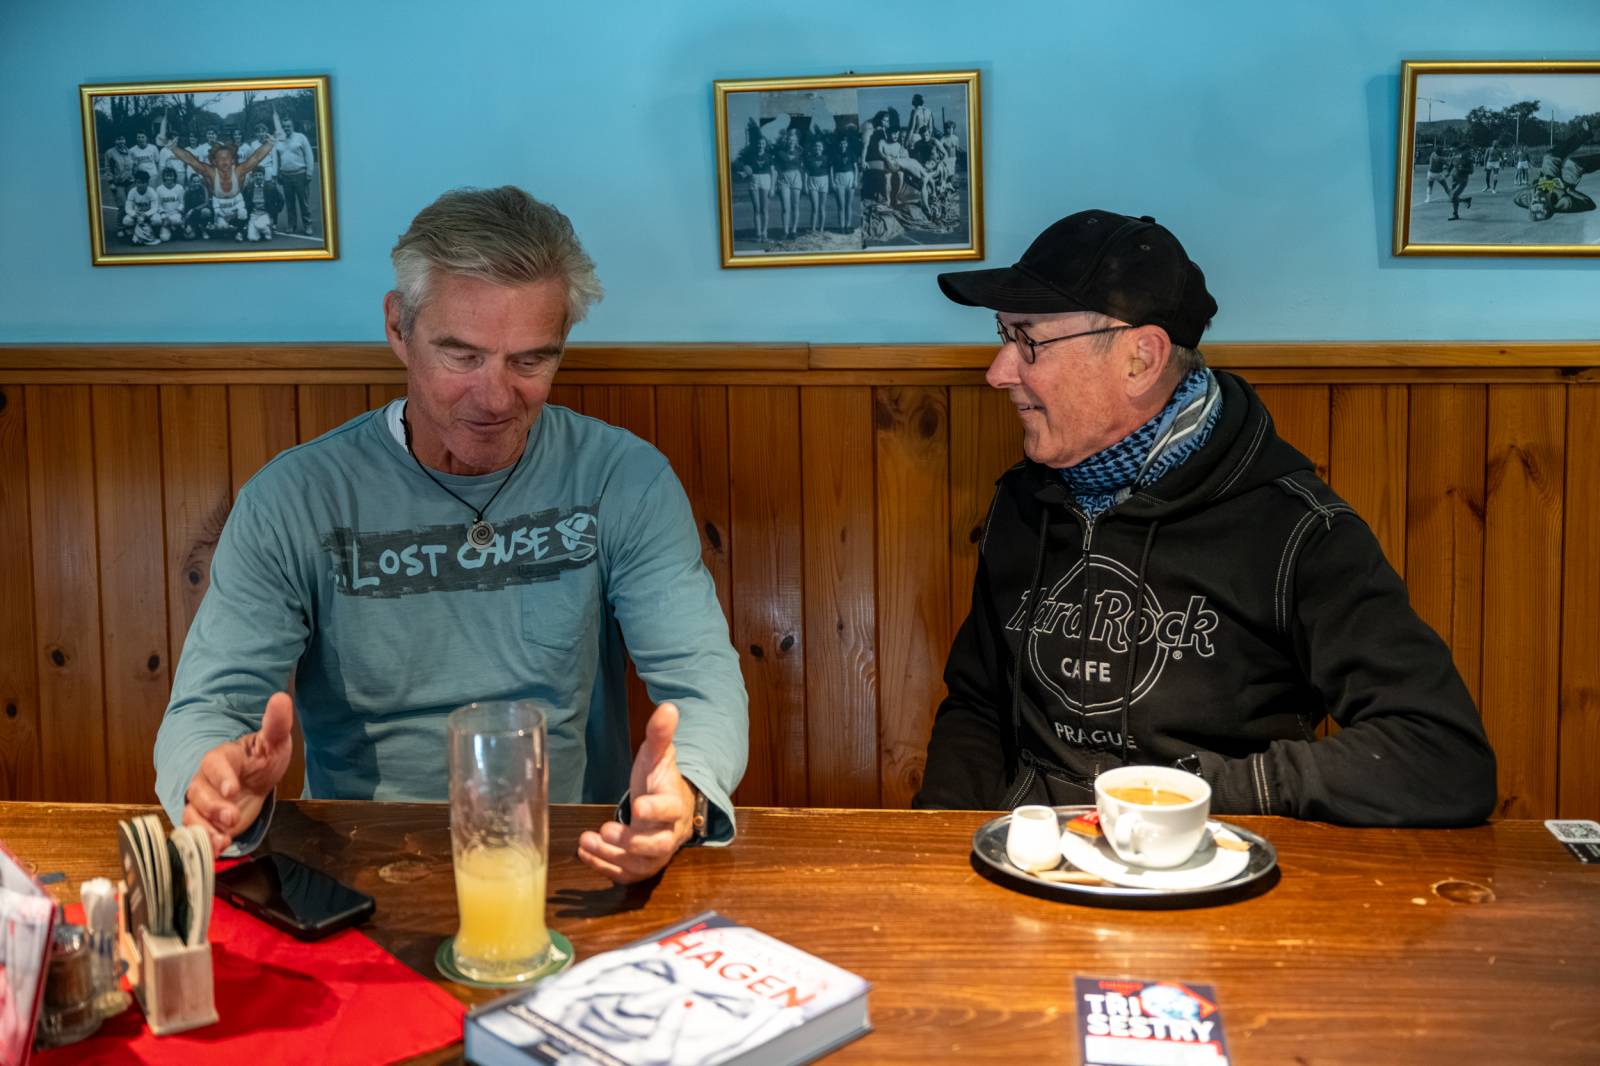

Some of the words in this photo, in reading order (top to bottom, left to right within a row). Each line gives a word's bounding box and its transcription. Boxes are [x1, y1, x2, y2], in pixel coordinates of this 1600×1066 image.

[352, 539, 448, 590] LOST
[457, 526, 551, 569] CAUSE
[1089, 589, 1219, 657] Rock
[1061, 657, 1111, 682] CAFE
[1054, 721, 1137, 749] PRAGUE
[657, 928, 817, 1009] HAGEN
[1084, 991, 1142, 1017] TRI
[1086, 1013, 1216, 1043] SESTRY
